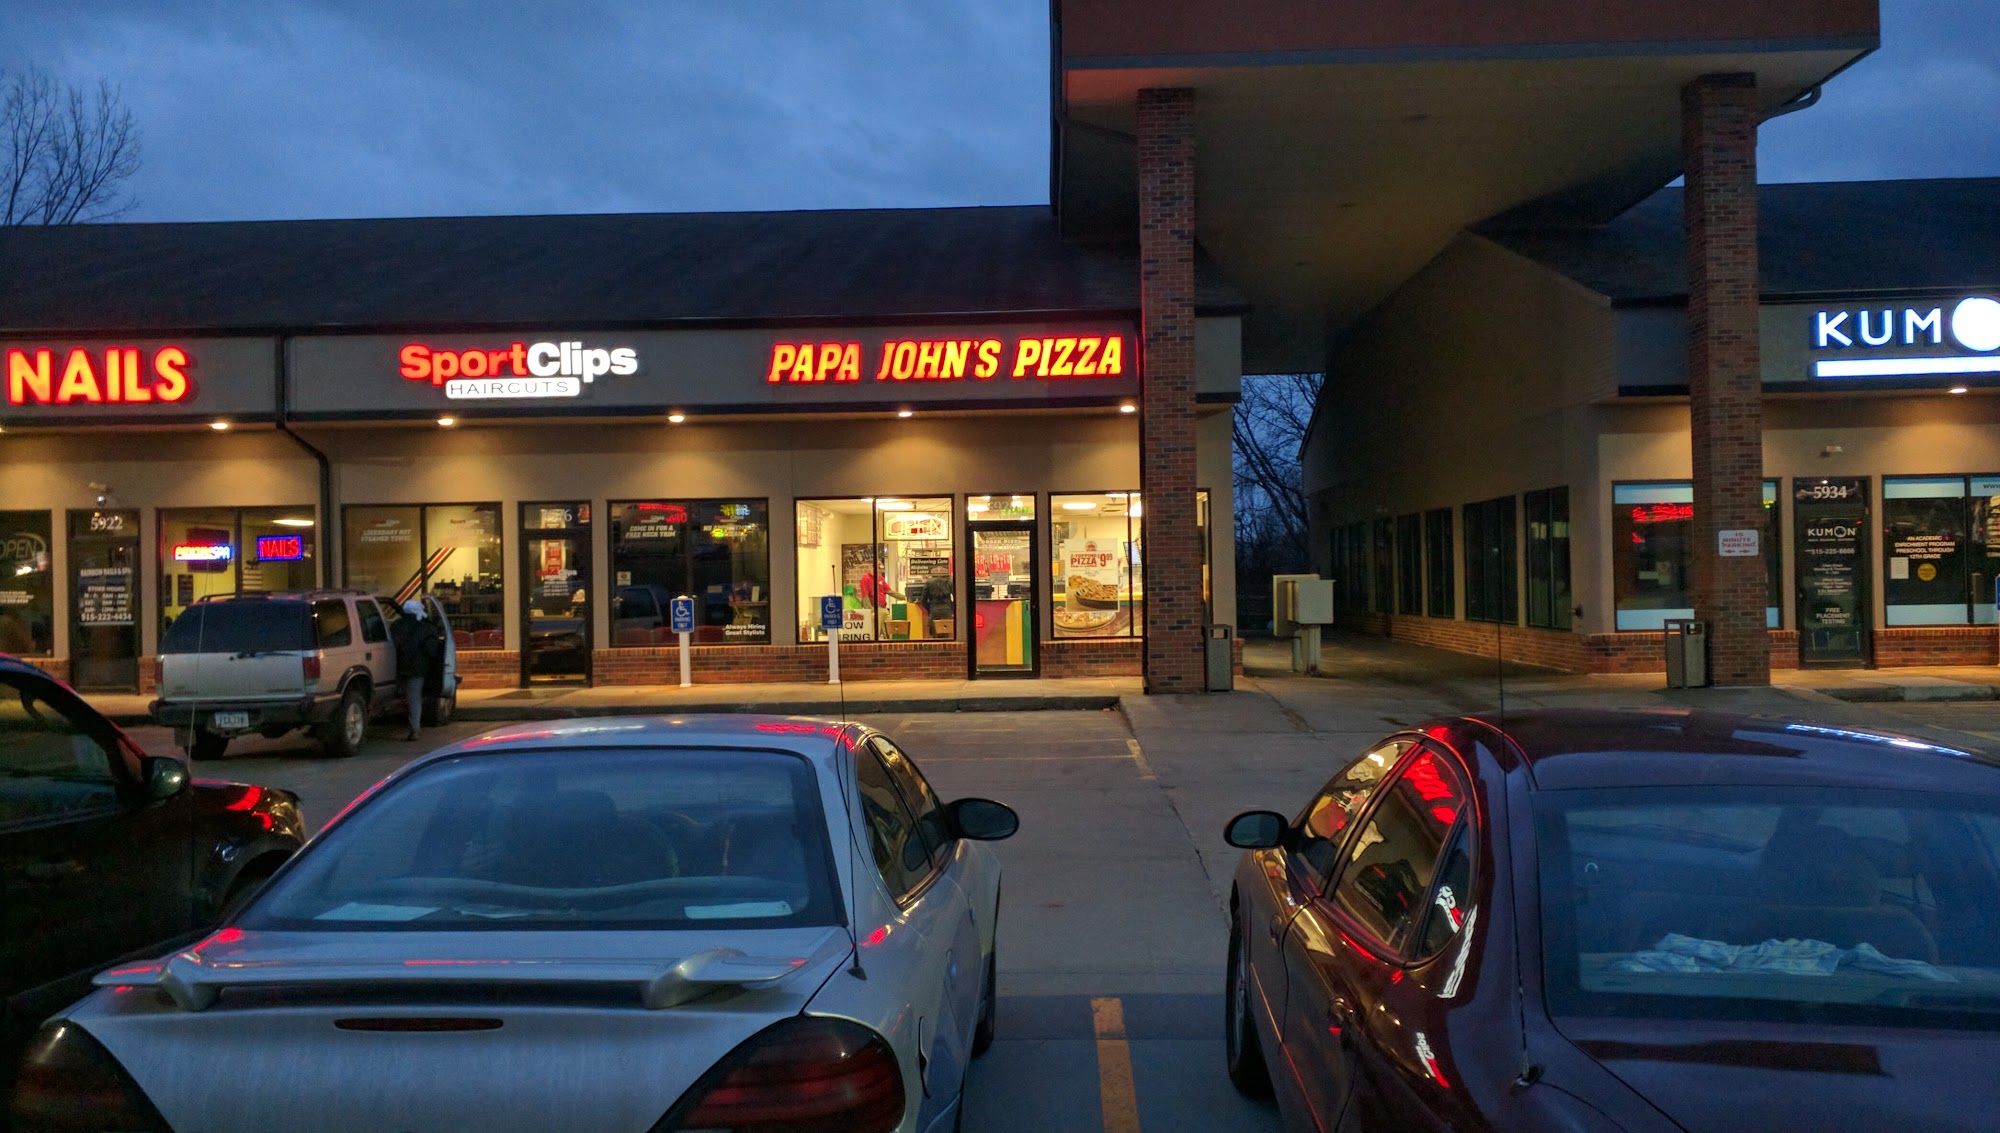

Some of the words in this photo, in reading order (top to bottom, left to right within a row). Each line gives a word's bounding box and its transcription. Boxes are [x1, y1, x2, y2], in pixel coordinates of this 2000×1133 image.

[768, 342, 860, 383] PAPA
[876, 339, 1002, 381] JOHN'S
[1012, 336, 1123, 378] PIZZA
[7, 346, 190, 404] NAILS
[450, 381, 570, 396] HAIRCUTS
[1813, 486, 1848, 498] 5934
[90, 516, 123, 531] 5922
[1808, 526, 1856, 538] KUMON
[260, 539, 299, 558] NAILS
[1071, 557, 1097, 565] PIZZA
[844, 621, 864, 629] OW
[839, 633, 871, 641] RING
